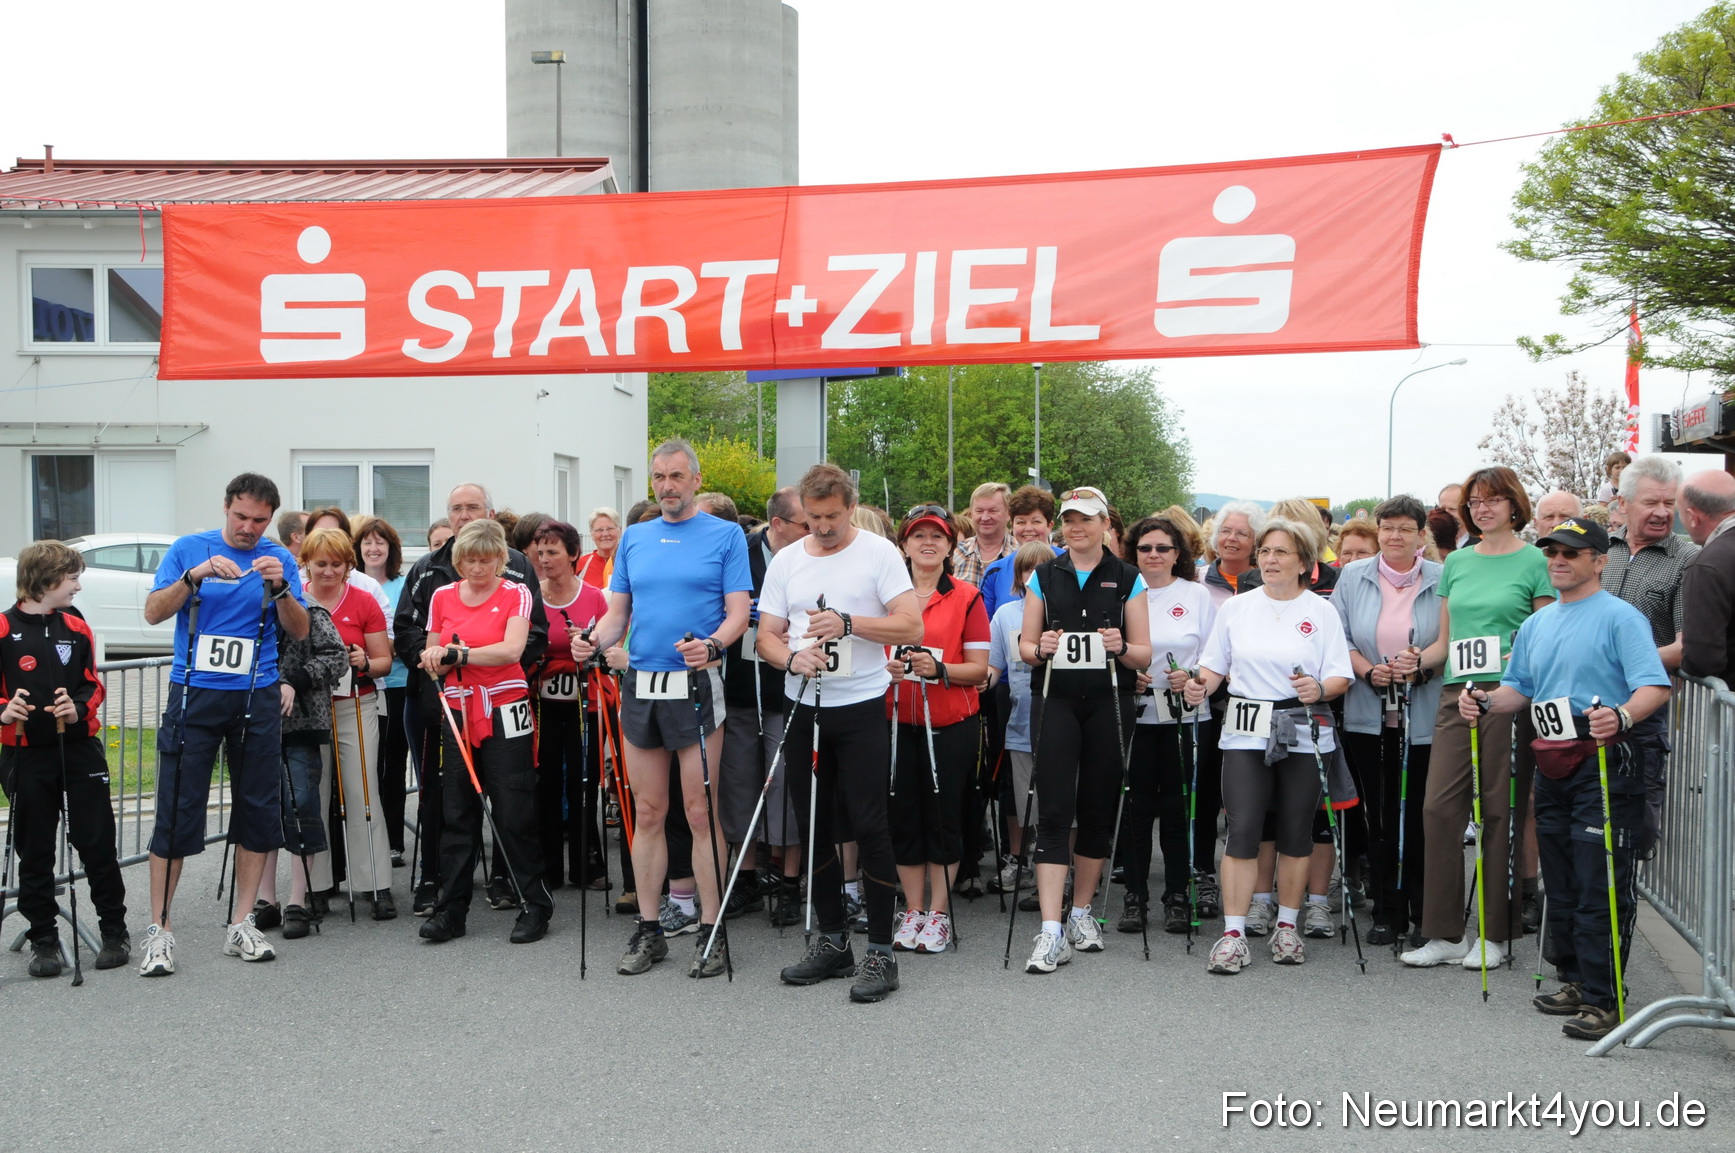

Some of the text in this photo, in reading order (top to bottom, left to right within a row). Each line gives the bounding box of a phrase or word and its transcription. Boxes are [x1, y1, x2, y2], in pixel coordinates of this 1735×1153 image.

[1682, 405, 1706, 428] SEAT
[209, 638, 243, 669] 50
[1067, 634, 1091, 664] 91
[1456, 638, 1487, 671] 119
[547, 673, 574, 696] 30
[509, 702, 532, 732] 12
[1235, 701, 1261, 732] 117
[1534, 702, 1564, 737] 89
